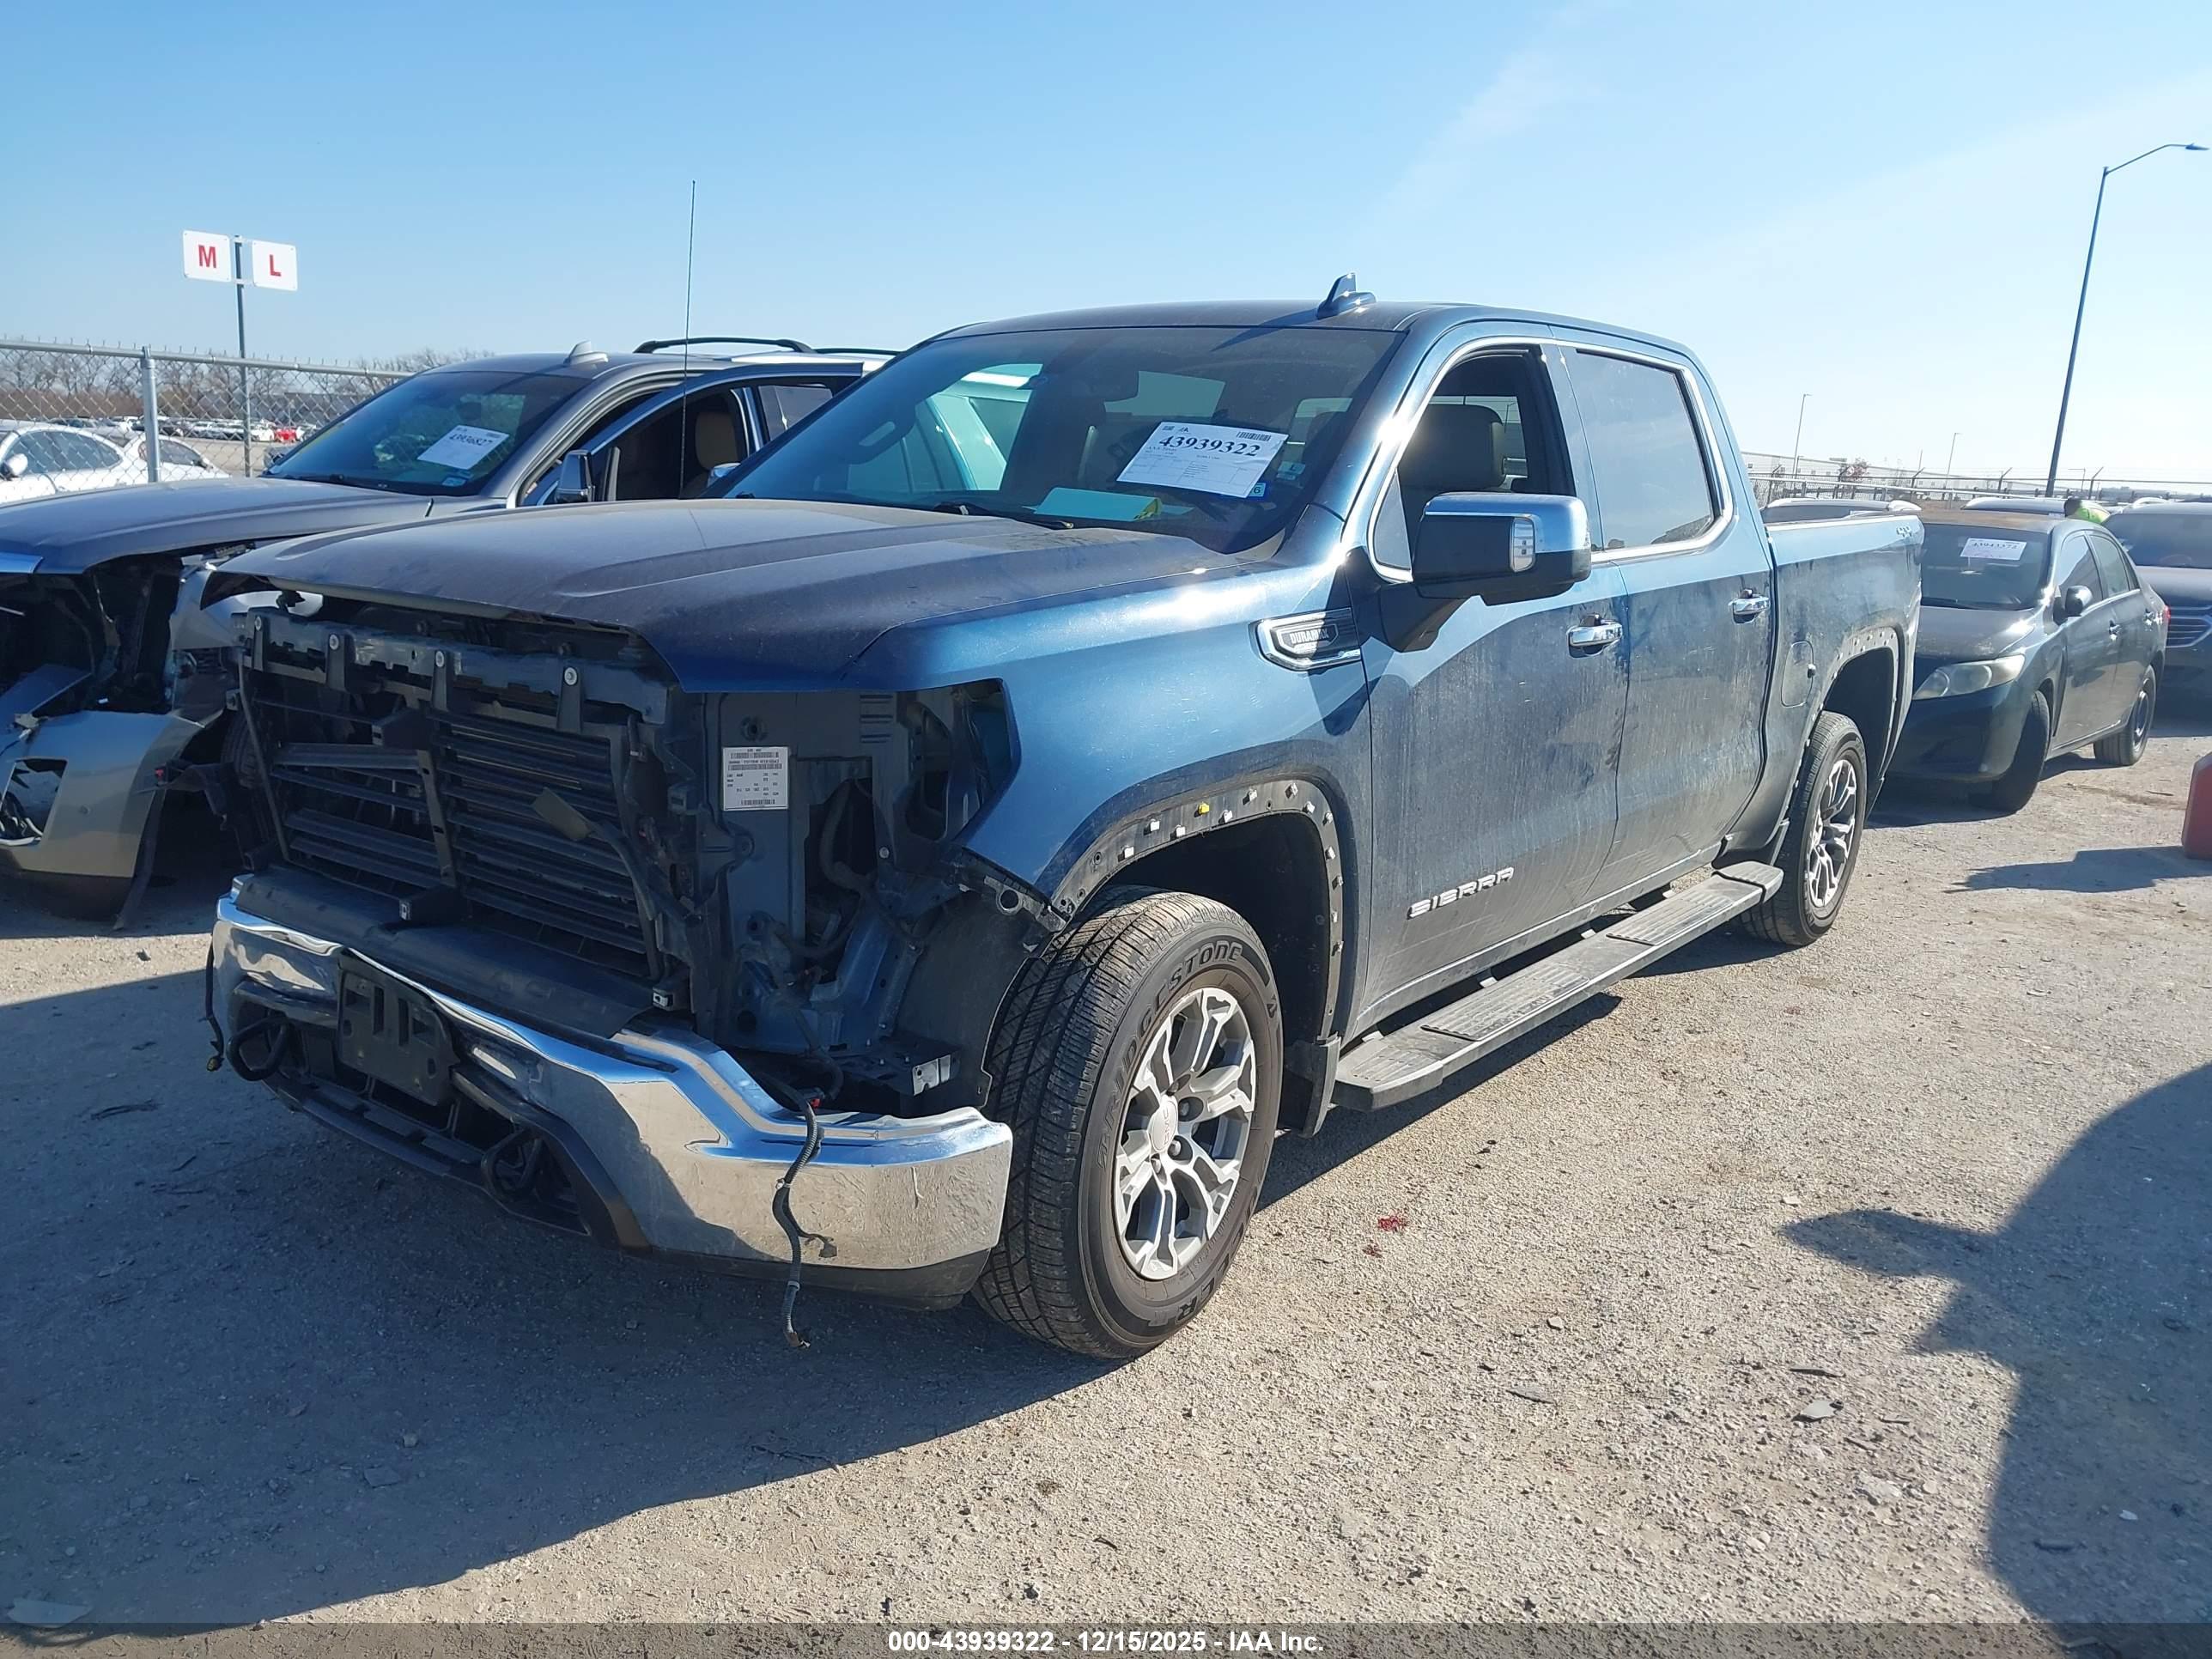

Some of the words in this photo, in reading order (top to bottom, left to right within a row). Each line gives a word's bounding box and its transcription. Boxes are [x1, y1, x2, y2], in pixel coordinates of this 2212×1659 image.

[198, 244, 216, 268] M
[269, 254, 281, 276] L
[1159, 434, 1261, 457] 43939322
[1289, 628, 1329, 644] DURAMAX
[1407, 866, 1514, 920] SIERRA
[1095, 939, 1243, 1170] BRIDGESTONE
